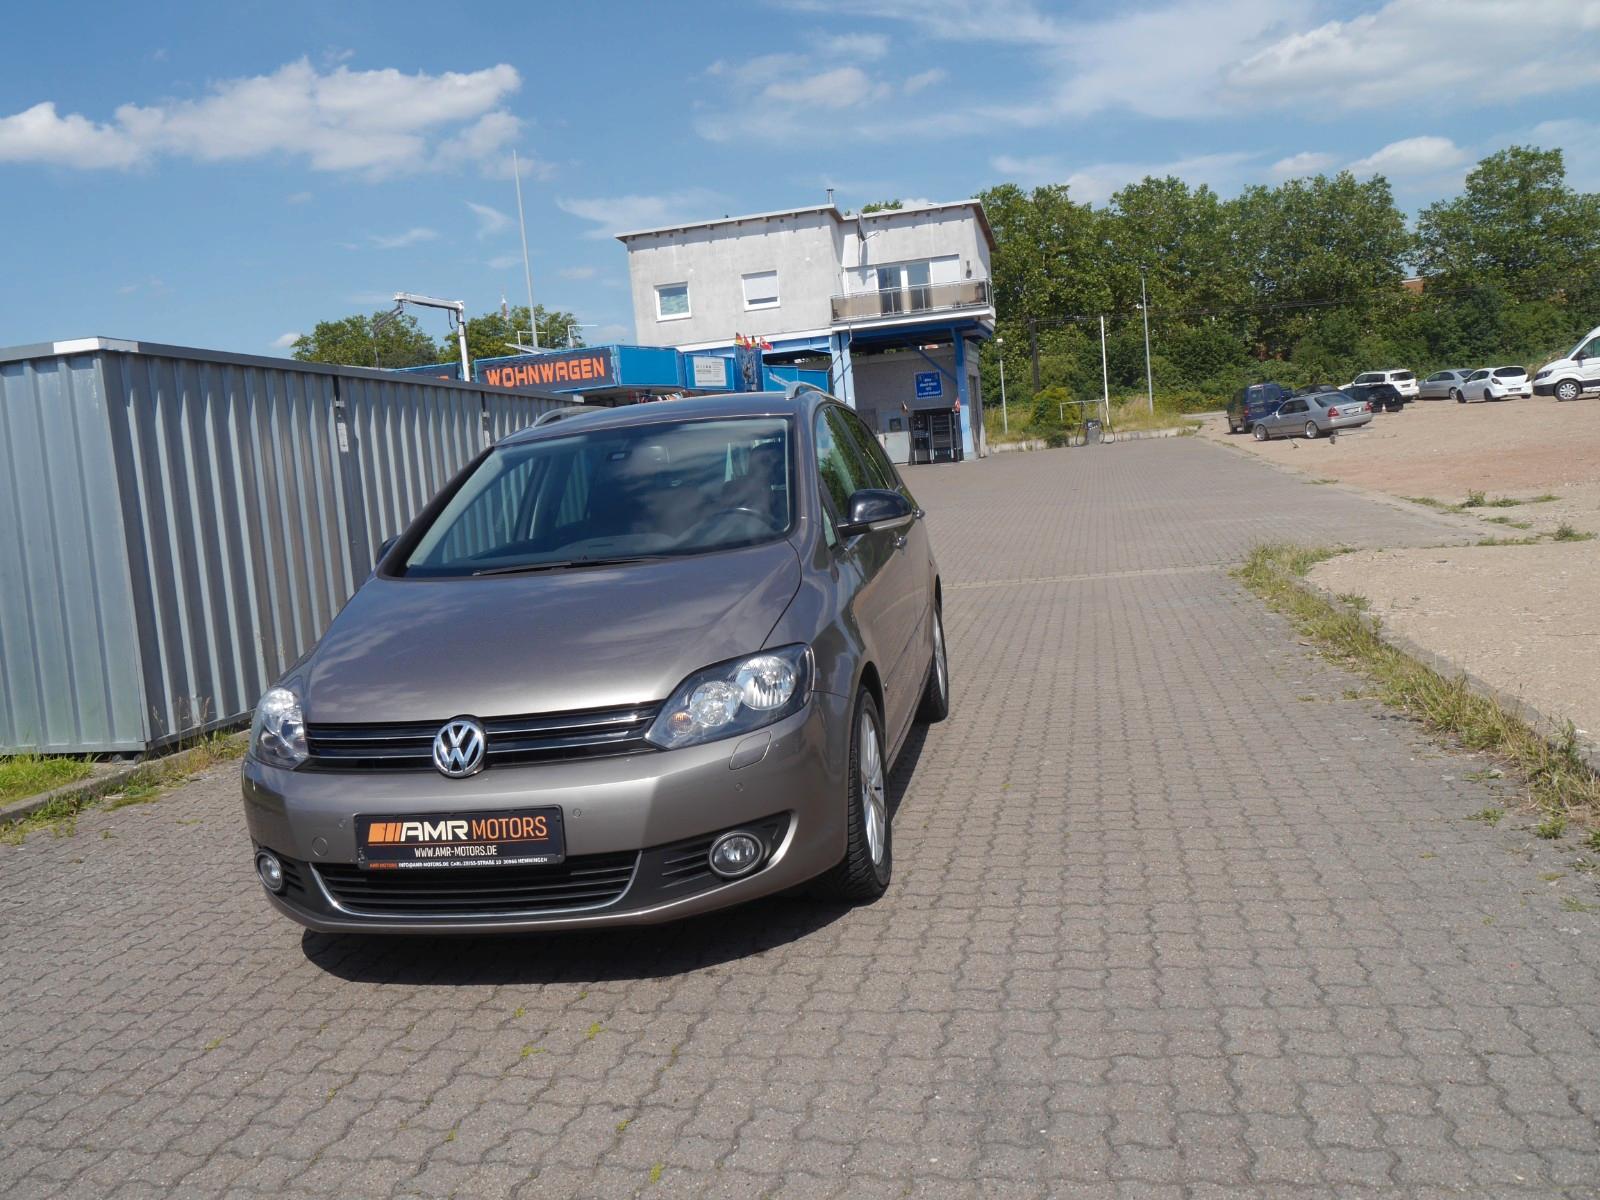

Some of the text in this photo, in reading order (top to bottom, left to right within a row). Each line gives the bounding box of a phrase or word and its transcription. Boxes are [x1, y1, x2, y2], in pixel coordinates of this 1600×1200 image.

[486, 357, 604, 388] WOHNWAGEN
[400, 815, 548, 842] AMR MOTORS
[414, 844, 498, 858] WWW.AMR-MOTORS.DE
